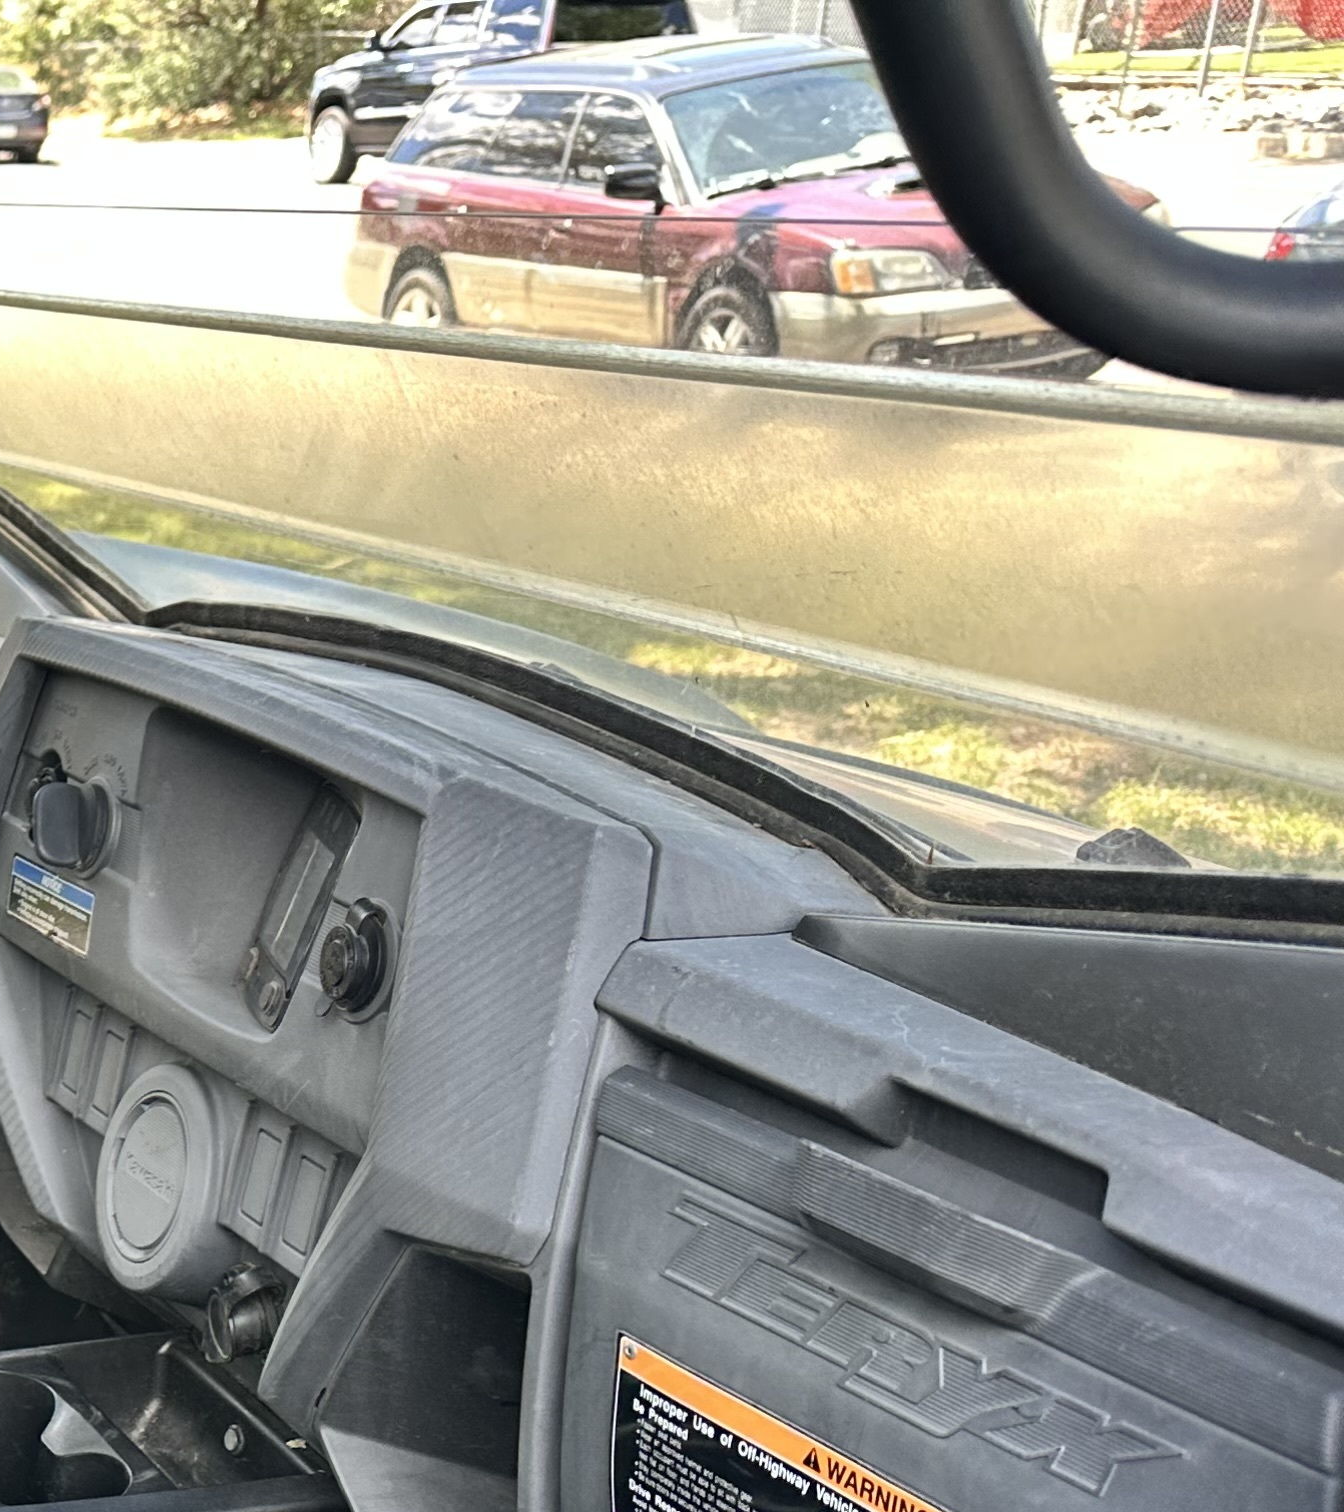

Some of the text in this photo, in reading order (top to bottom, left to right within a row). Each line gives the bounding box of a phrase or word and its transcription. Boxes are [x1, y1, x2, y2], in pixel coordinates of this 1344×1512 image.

[661, 1188, 1190, 1498] TERYX
[632, 1397, 644, 1414] Be
[648, 1407, 688, 1440] Prepared
[639, 1383, 687, 1422] Improper
[692, 1414, 714, 1438] Use
[719, 1433, 733, 1448] of
[737, 1440, 810, 1495] Off-Highway
[628, 1478, 651, 1500] Drive
